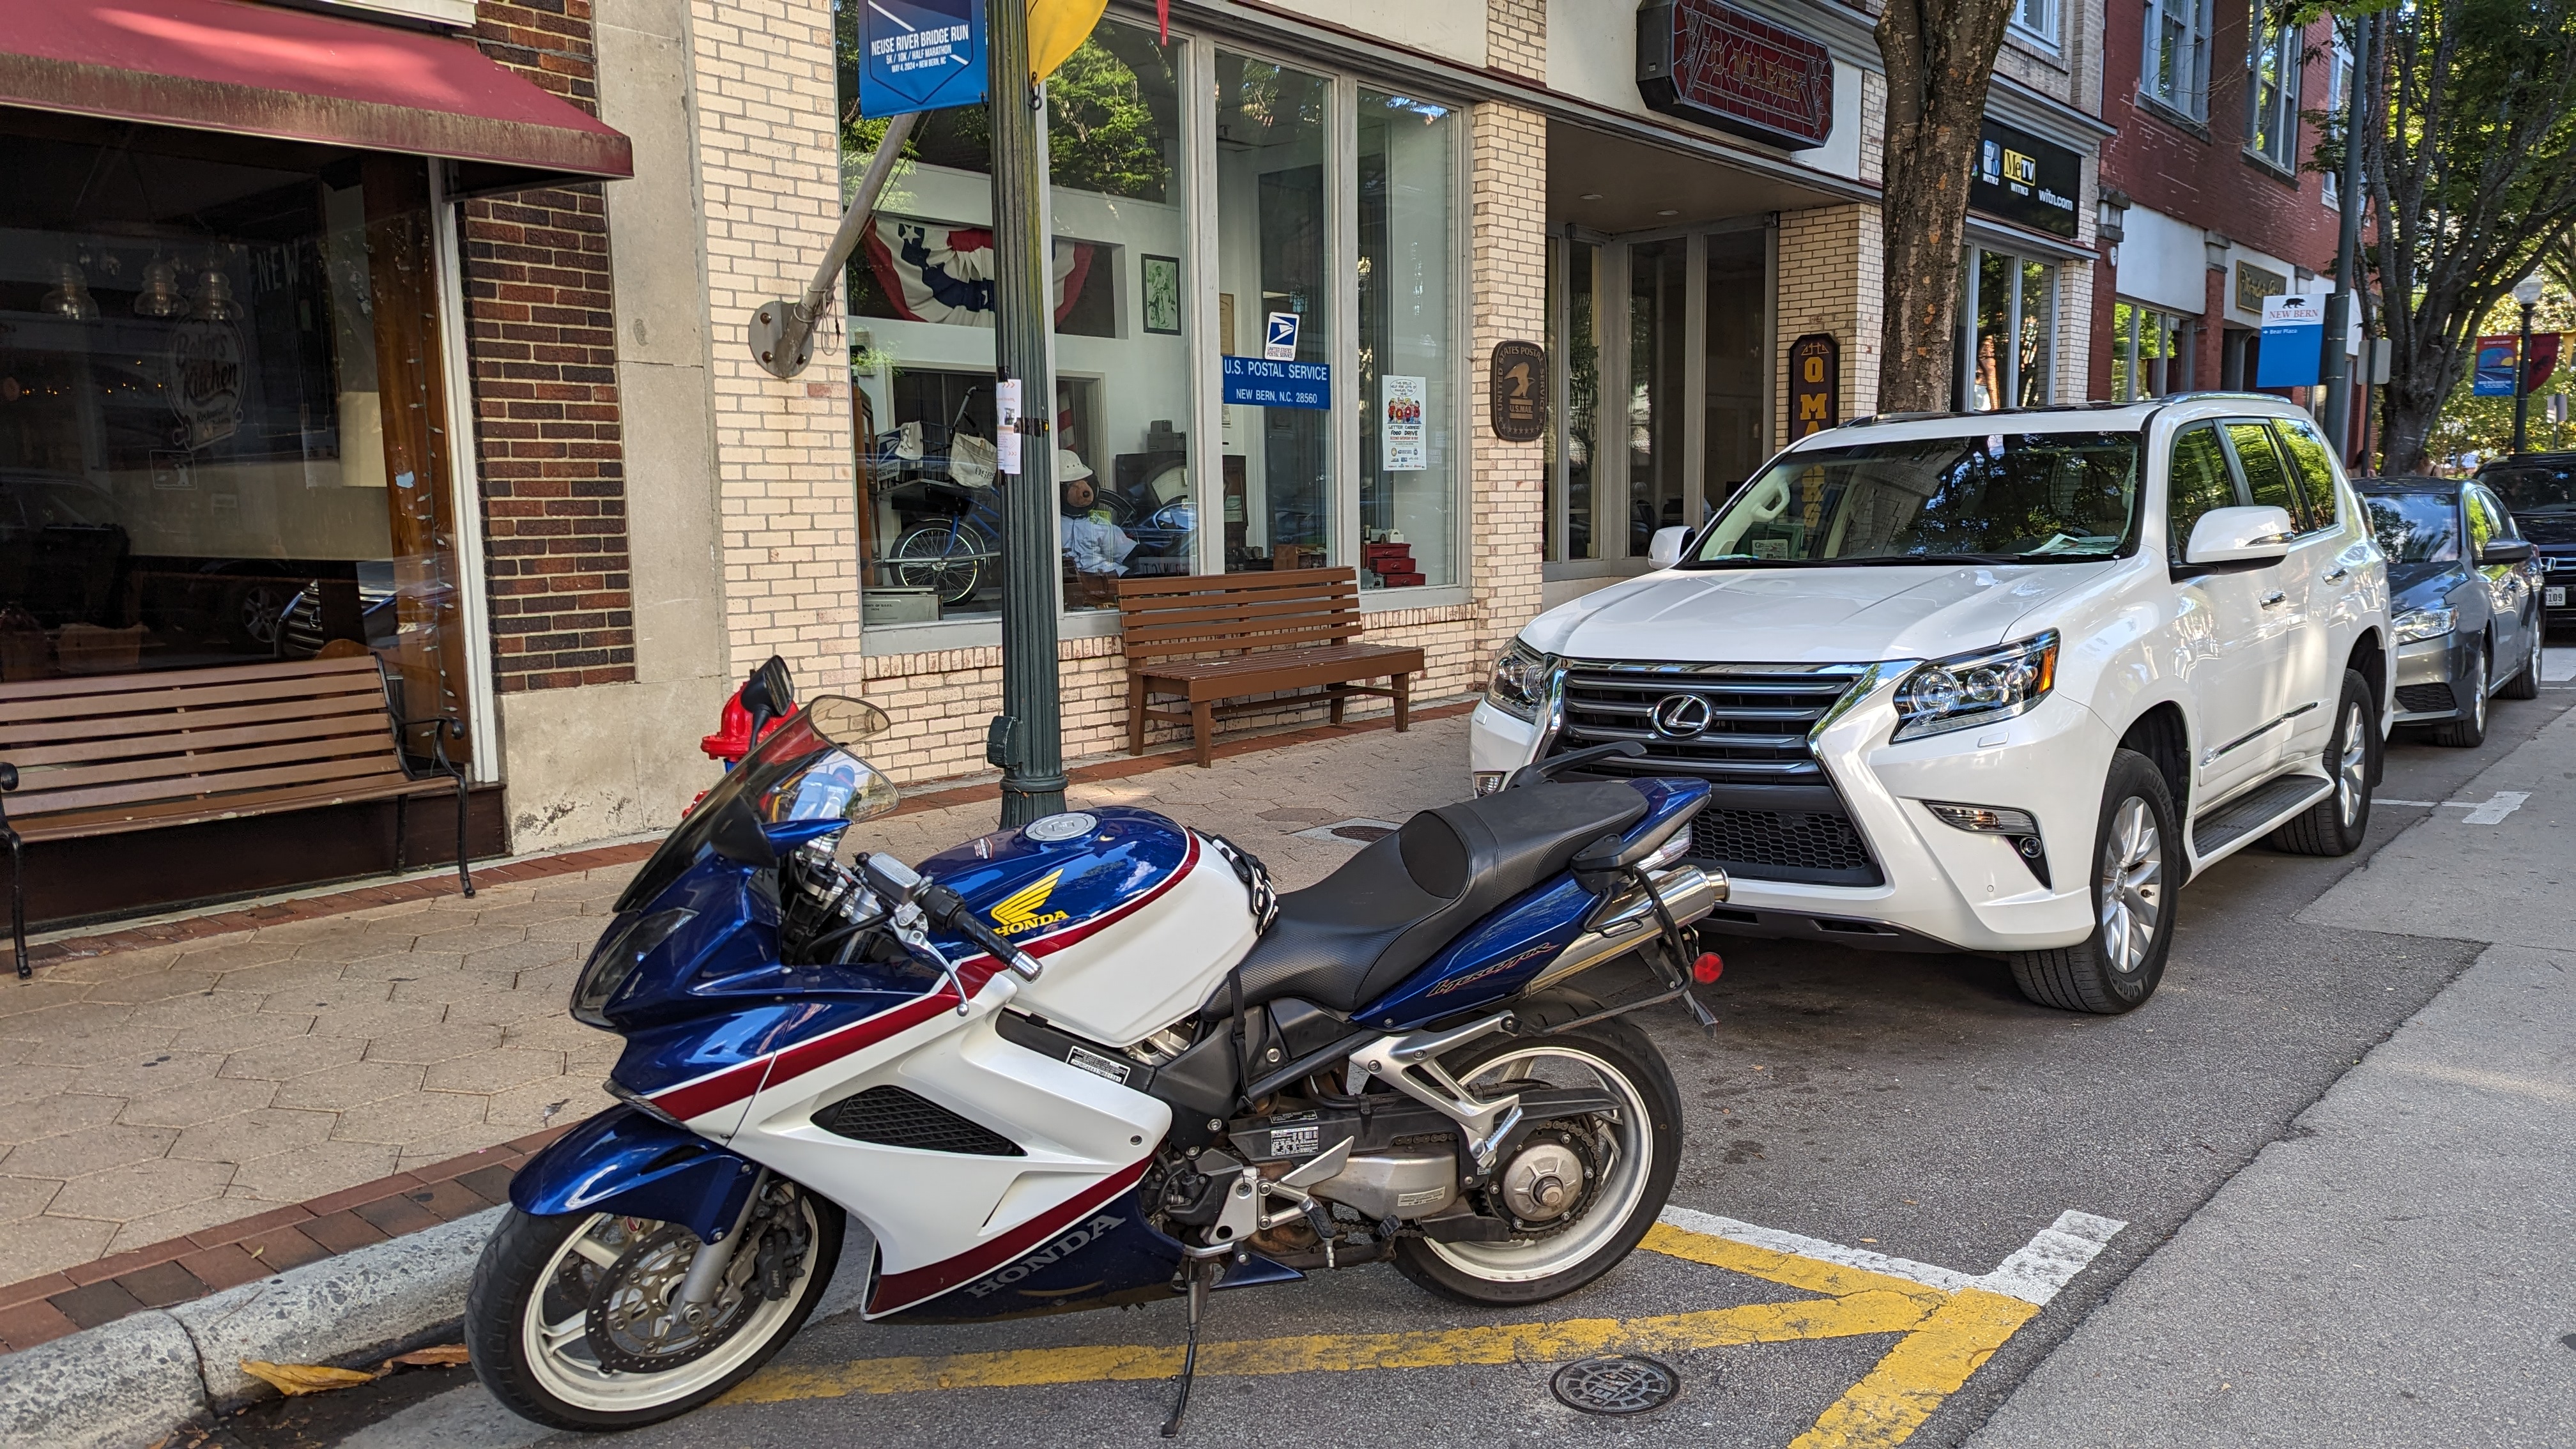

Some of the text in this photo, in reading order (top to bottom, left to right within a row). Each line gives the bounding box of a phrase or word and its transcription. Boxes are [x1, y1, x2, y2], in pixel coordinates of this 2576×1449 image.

[871, 24, 969, 56] NEUSE RIVER BRIDGE RUN
[886, 54, 893, 65] 5K
[898, 52, 907, 63] 10K
[912, 49, 924, 60] HALF
[924, 44, 952, 58] MARATHON
[891, 64, 900, 73] MAY
[904, 61, 916, 71] 2024
[919, 59, 928, 68] NEW
[940, 56, 946, 65] NC
[1732, 47, 1800, 102] MARKS
[1984, 143, 1995, 160] my
[1982, 172, 2000, 186] WITN2
[2011, 182, 2029, 196] WITN3
[2038, 188, 2073, 211] witn.com
[2269, 309, 2319, 319] NEW BERN
[1498, 346, 1519, 365] STATES
[1521, 346, 1544, 365] POSTAL
[1224, 359, 1327, 381] U.S. POSTAL SERVICE
[183, 361, 238, 407] Kitchen
[1236, 388, 1317, 404] NEW BERN, N.C. 28560
[992, 910, 1070, 937] HONDA
[1425, 942, 1562, 997] INTERCEPTOR
[963, 1214, 1127, 1298] HONDA
